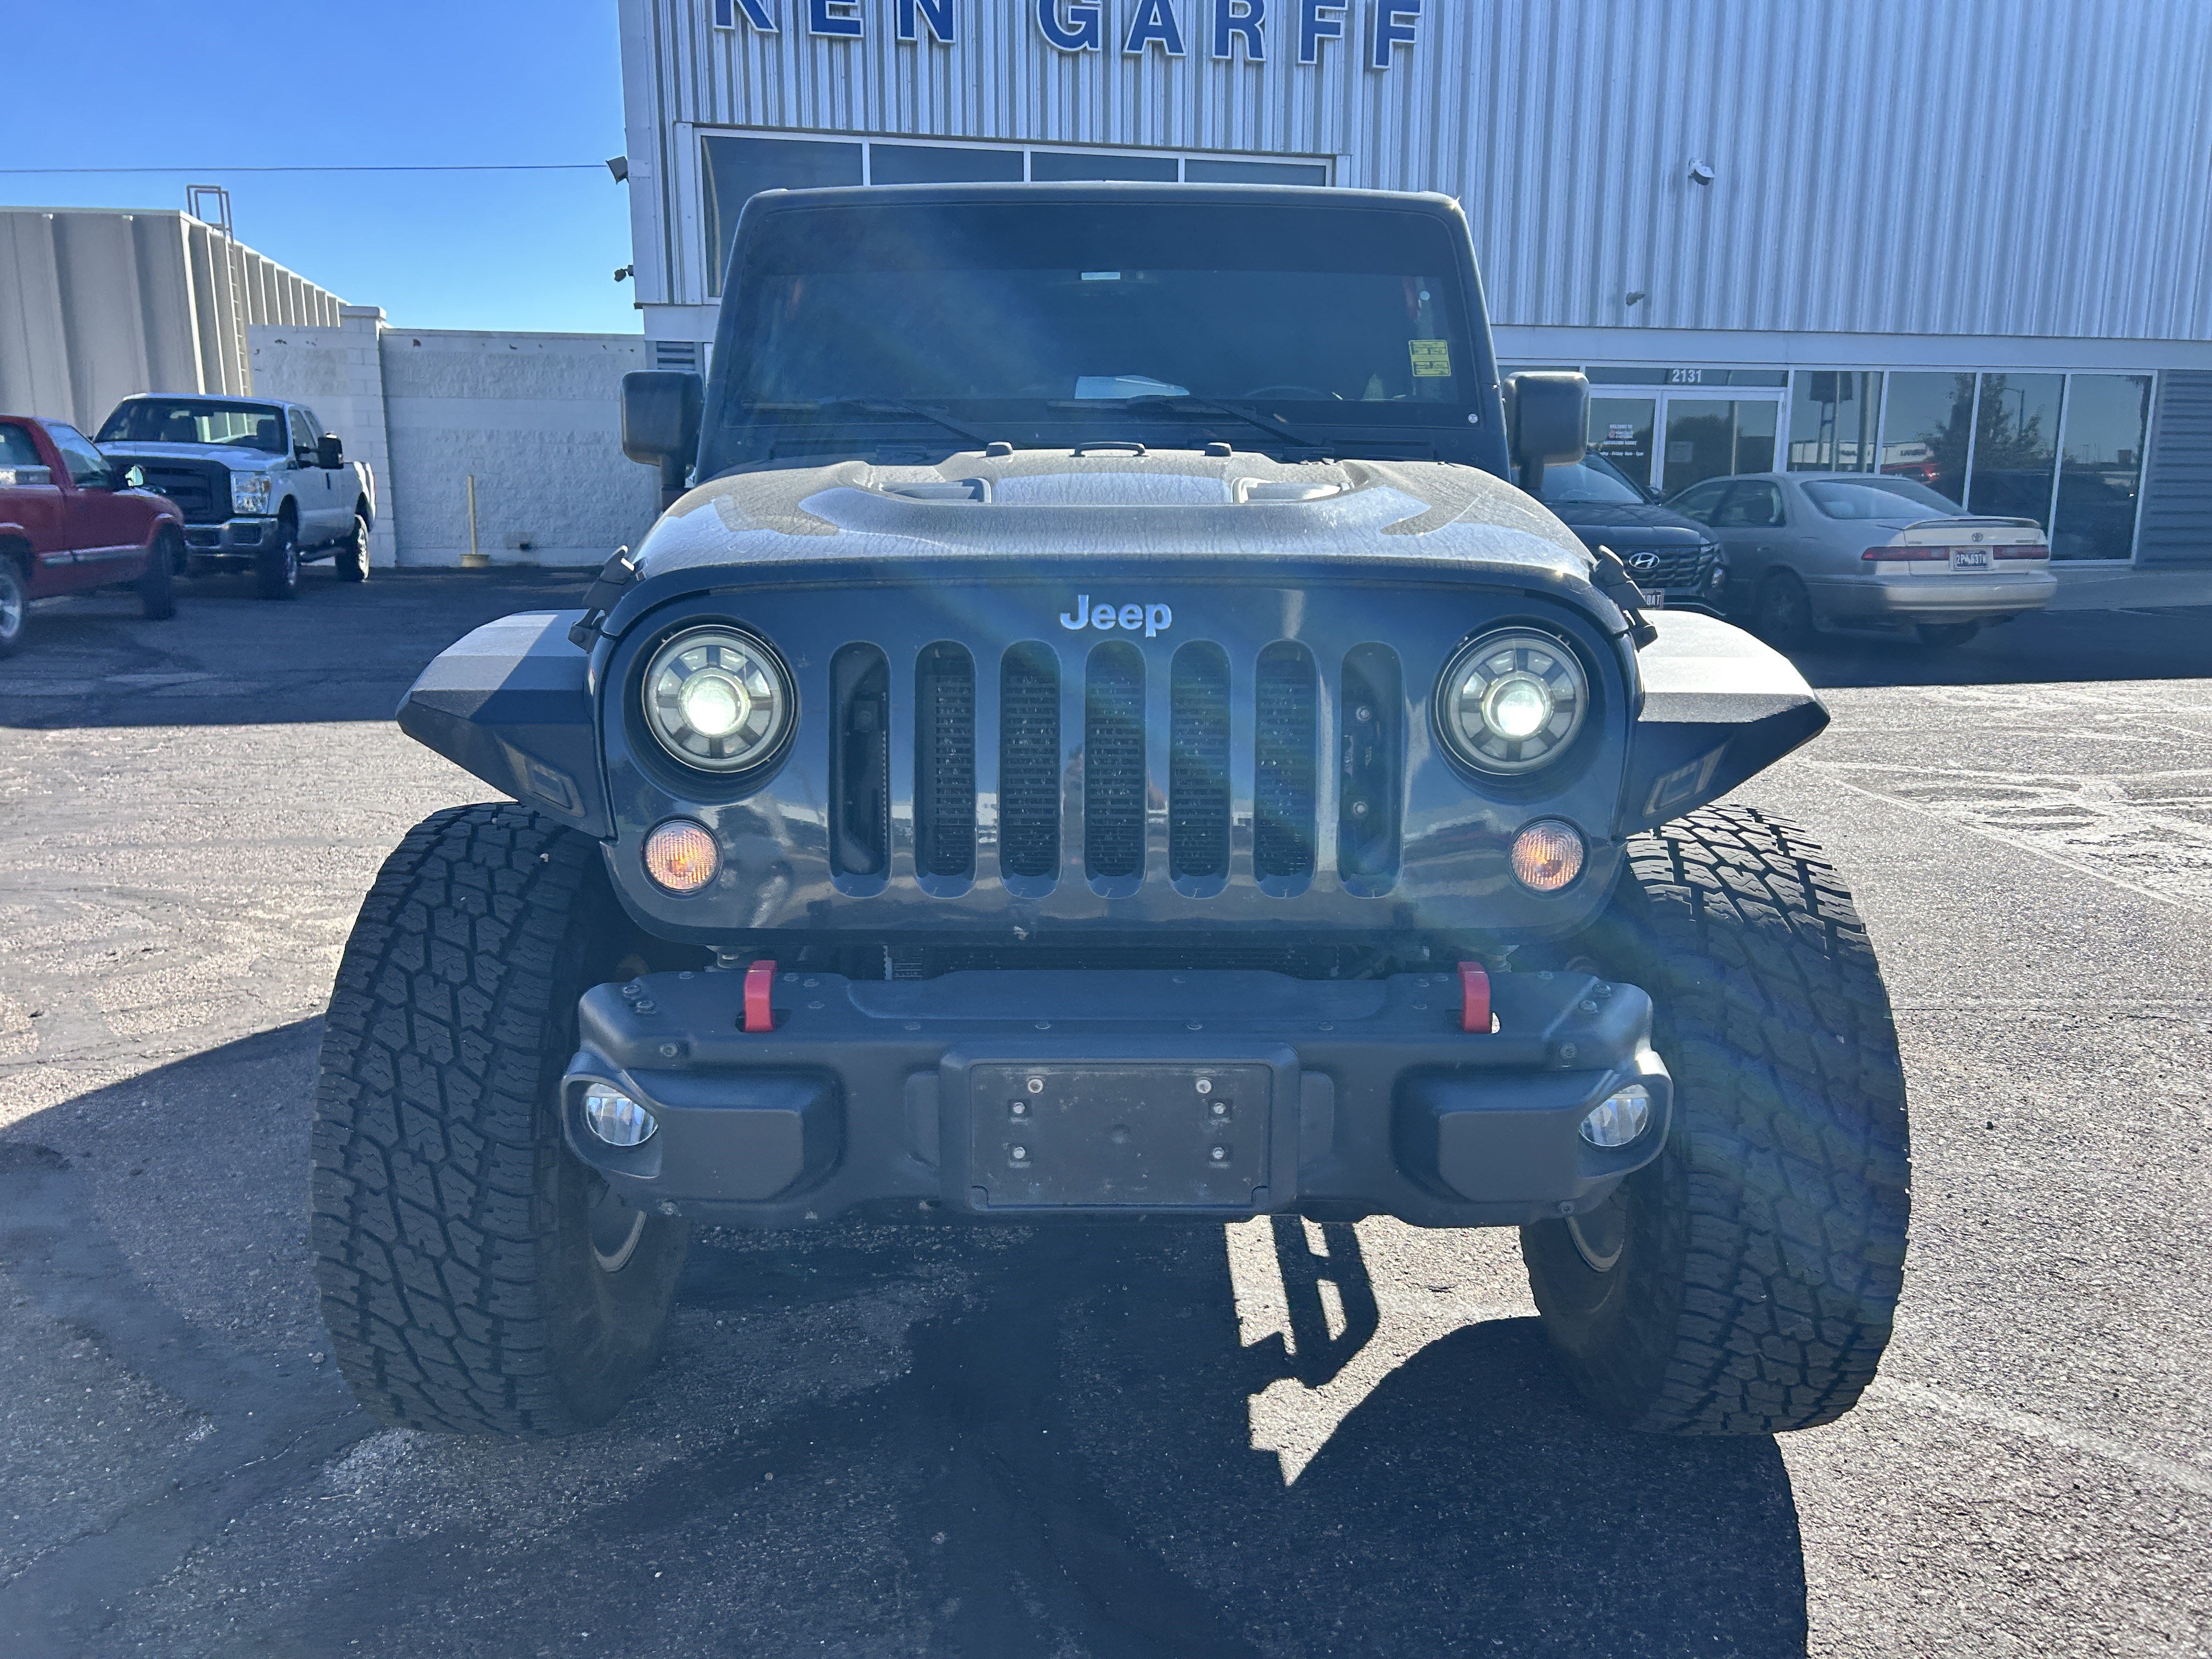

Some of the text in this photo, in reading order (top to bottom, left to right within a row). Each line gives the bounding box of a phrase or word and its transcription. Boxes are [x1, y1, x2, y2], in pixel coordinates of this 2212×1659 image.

[1036, 0, 1421, 69] GARFF
[1672, 369, 1702, 383] 2131
[1060, 594, 1172, 637] Jeep
